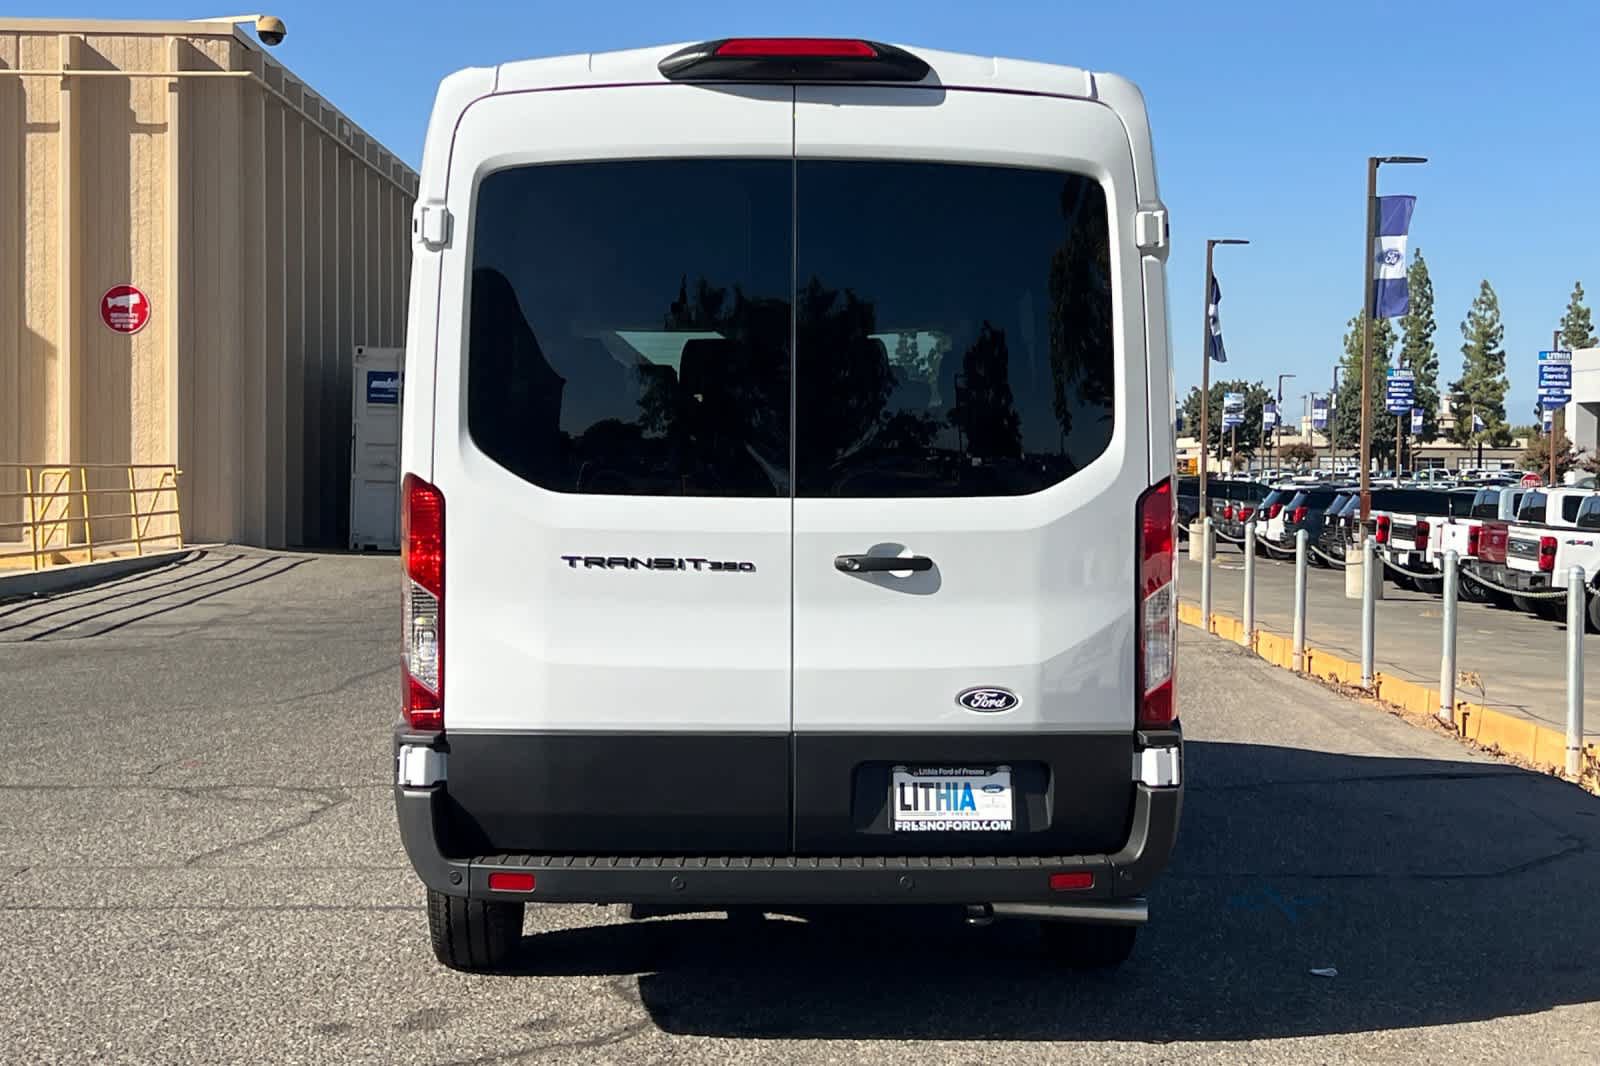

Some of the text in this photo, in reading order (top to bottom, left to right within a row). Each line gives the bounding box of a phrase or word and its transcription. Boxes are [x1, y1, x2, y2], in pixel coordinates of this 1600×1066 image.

[561, 556, 756, 572] TRANSIT 350
[971, 693, 1006, 708] Ford
[900, 782, 977, 811] LITHIA
[894, 820, 1012, 831] FRESNOFORD.COM
